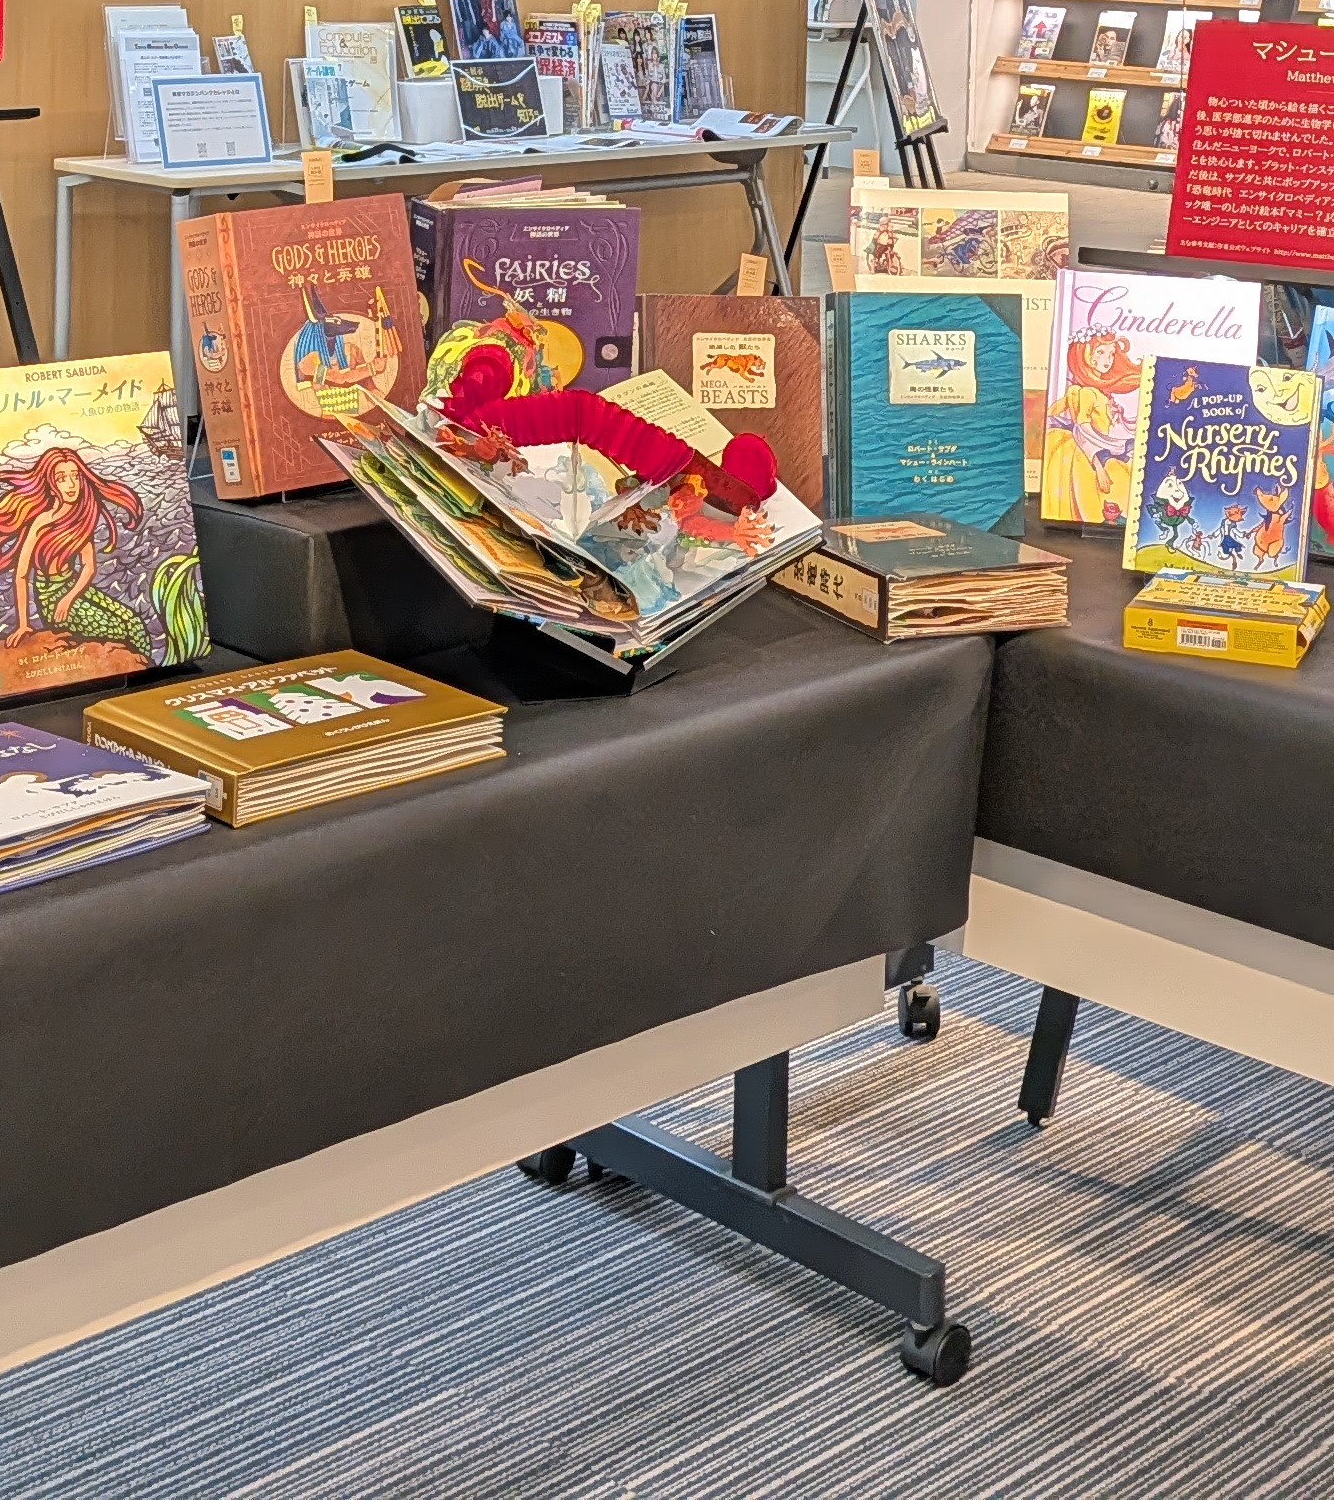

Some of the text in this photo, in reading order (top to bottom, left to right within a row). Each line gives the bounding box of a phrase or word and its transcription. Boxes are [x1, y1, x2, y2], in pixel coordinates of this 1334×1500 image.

[318, 28, 374, 43] Computer
[528, 31, 564, 44] エコノミスト
[319, 43, 377, 57] Education
[529, 45, 573, 58] 戦争で変わる
[537, 59, 576, 77] 界経済
[272, 244, 312, 274] GODS
[315, 244, 326, 263] &
[329, 235, 381, 264] HEROES
[187, 267, 210, 292] GODS
[288, 265, 372, 288] 神々と英雄
[189, 293, 222, 317] HEROES
[1074, 285, 1244, 340] Cinderella
[896, 333, 967, 346] SHARKS
[25, 365, 107, 383] ROBERT SABUDA
[700, 380, 729, 388] MEGA
[700, 389, 769, 405] BEASTS
[1187, 393, 1243, 410] A POP-UP
[1202, 404, 1249, 419] BOOK of
[1155, 416, 1279, 461] Nursery
[1181, 444, 1298, 495] Rhymes
